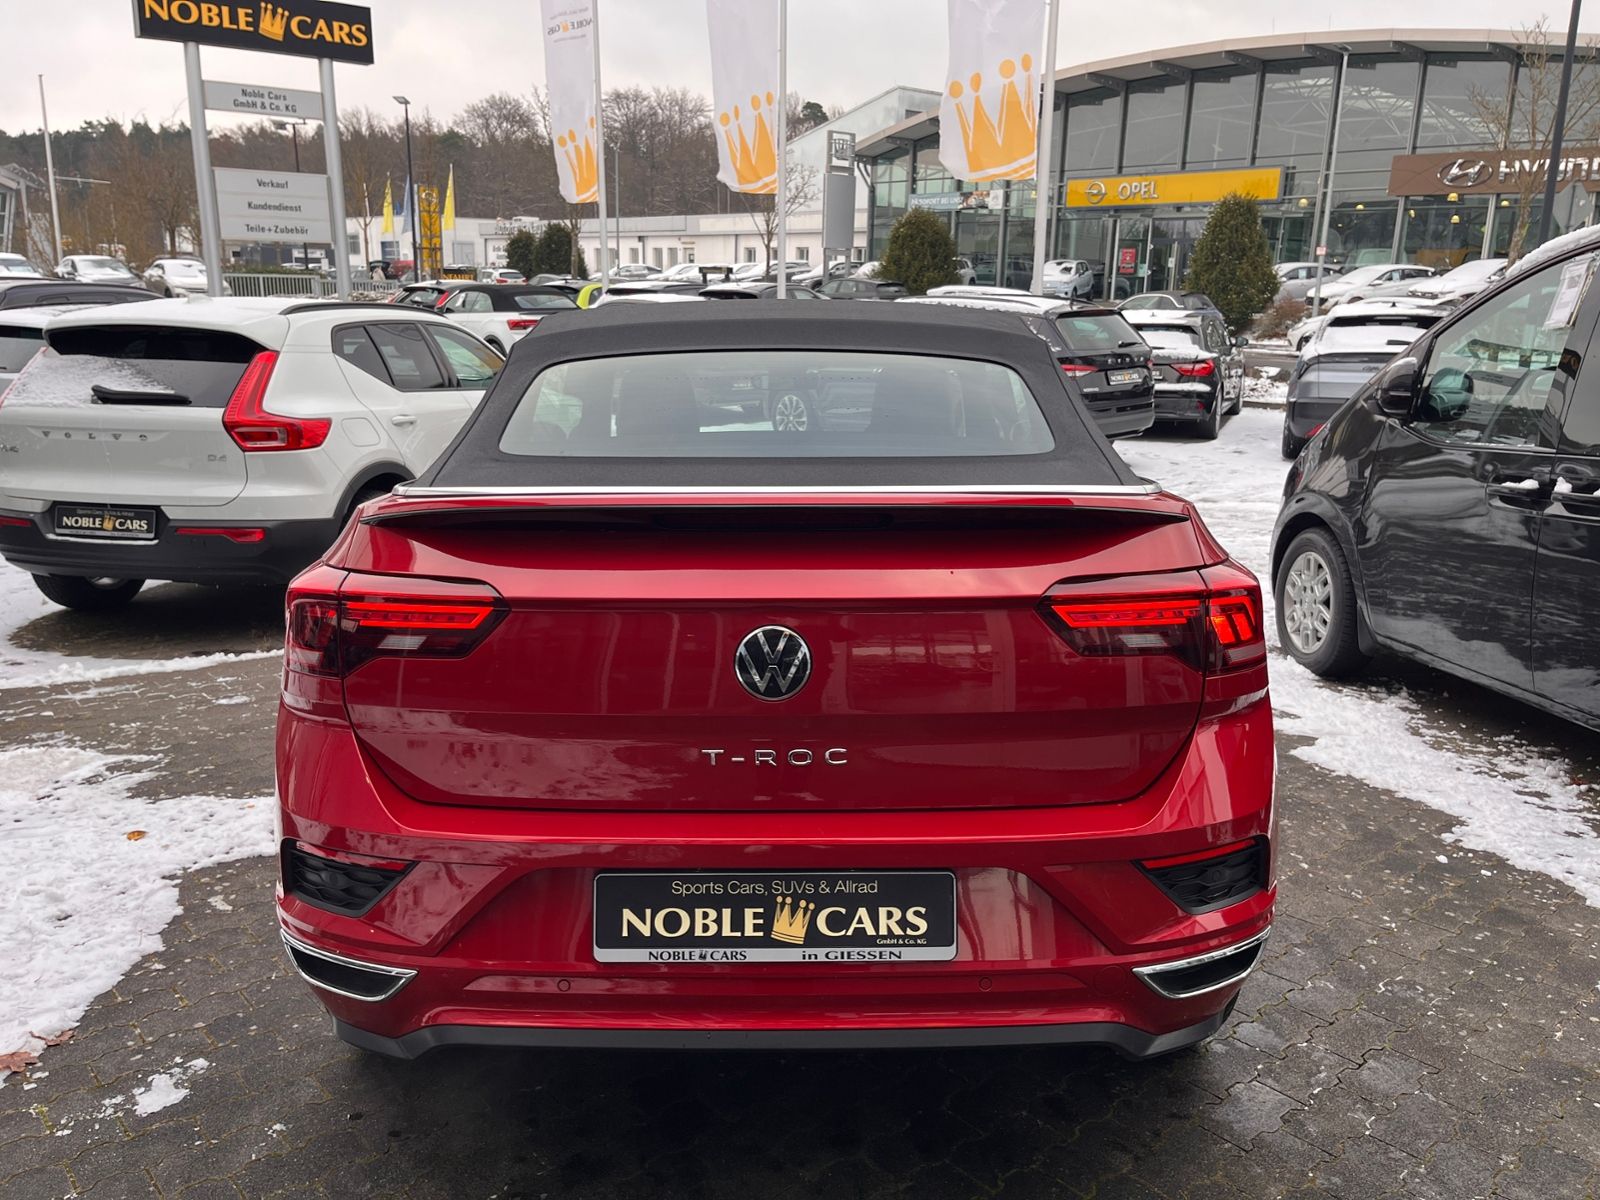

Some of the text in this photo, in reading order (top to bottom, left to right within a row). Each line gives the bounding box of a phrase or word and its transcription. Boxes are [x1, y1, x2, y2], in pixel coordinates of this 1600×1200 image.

[144, 0, 368, 47] NOBLE CARS
[241, 88, 288, 101] Noble Cars
[233, 98, 297, 113] GmbH & Co. KG
[256, 178, 289, 189] Verkauf
[1118, 181, 1159, 200] OPEL
[247, 201, 303, 212] Kundendienst
[245, 223, 309, 235] Teile+Zubehör
[42, 430, 148, 442] VOLVO
[207, 454, 228, 463] D4
[62, 516, 148, 531] NOBLE CARS
[702, 748, 848, 766] T-ROC
[671, 880, 879, 897] Sports Cars, SUVs & Allrad
[621, 906, 929, 938] NOBLE CARS
[648, 950, 747, 961] NOBLE CARS
[802, 950, 903, 960] in GIESSEN
